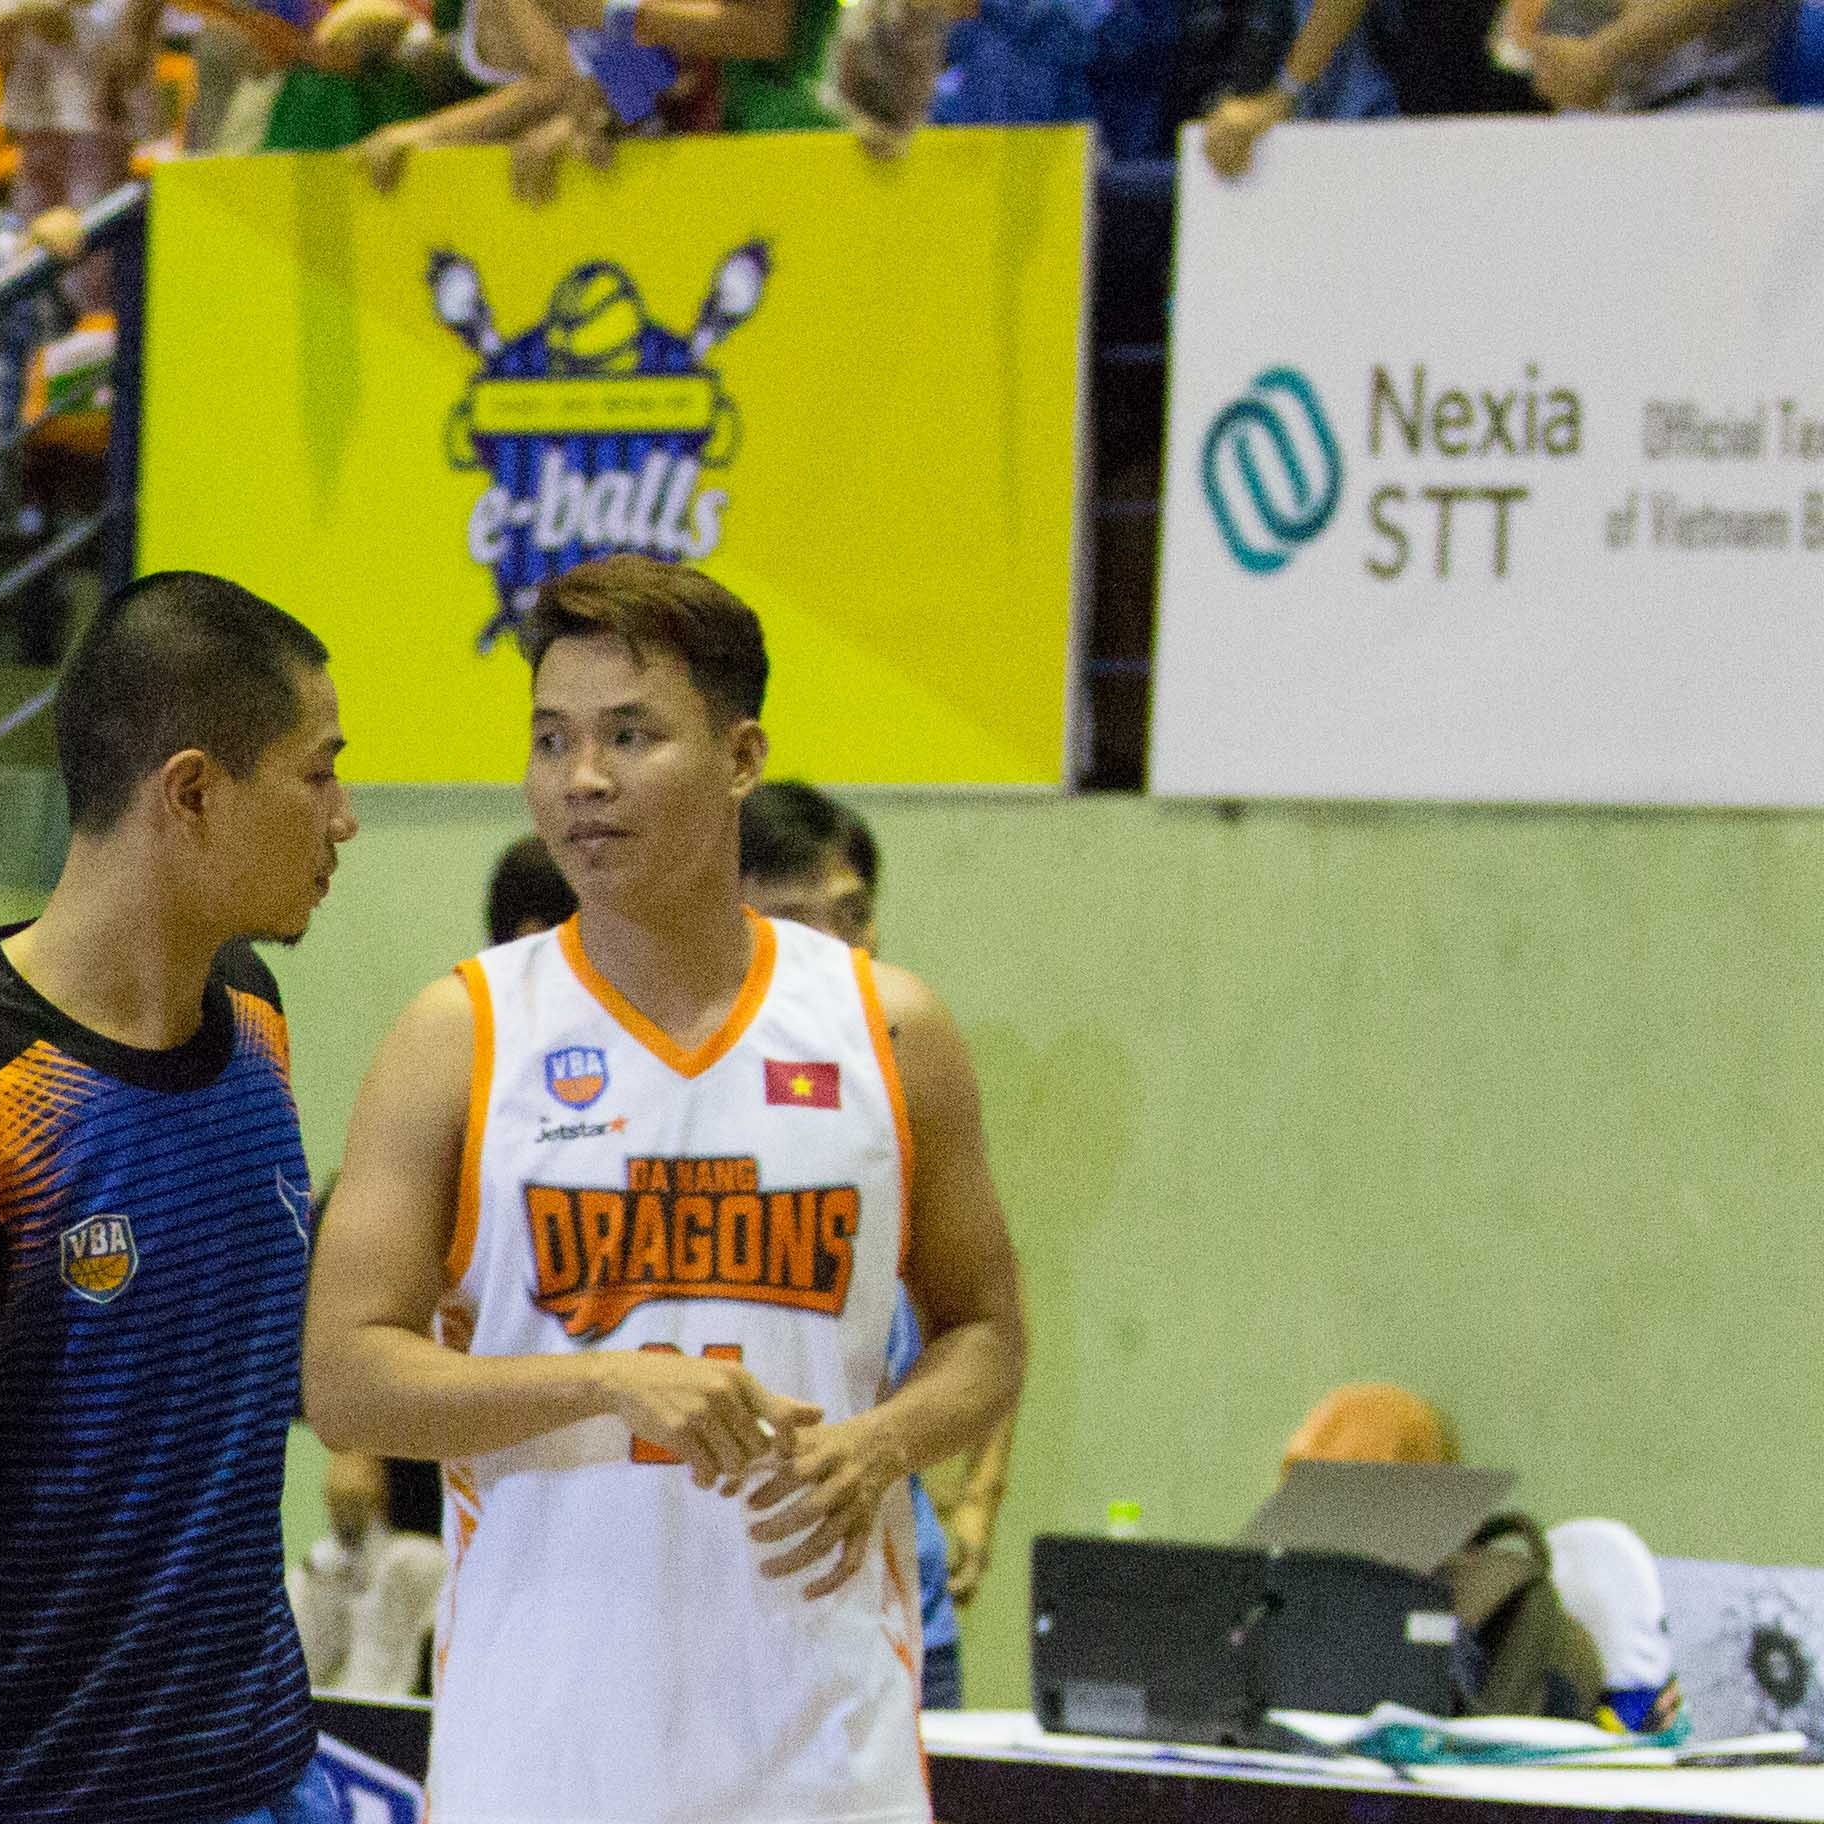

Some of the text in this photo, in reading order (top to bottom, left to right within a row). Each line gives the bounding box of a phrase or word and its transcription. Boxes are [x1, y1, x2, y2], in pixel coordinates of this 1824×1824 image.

[1368, 361, 1584, 459] Nexia
[468, 444, 730, 564] e-balls
[1364, 484, 1532, 580] STT
[68, 1222, 127, 1258] VBA
[526, 1185, 860, 1318] DRAGONS
